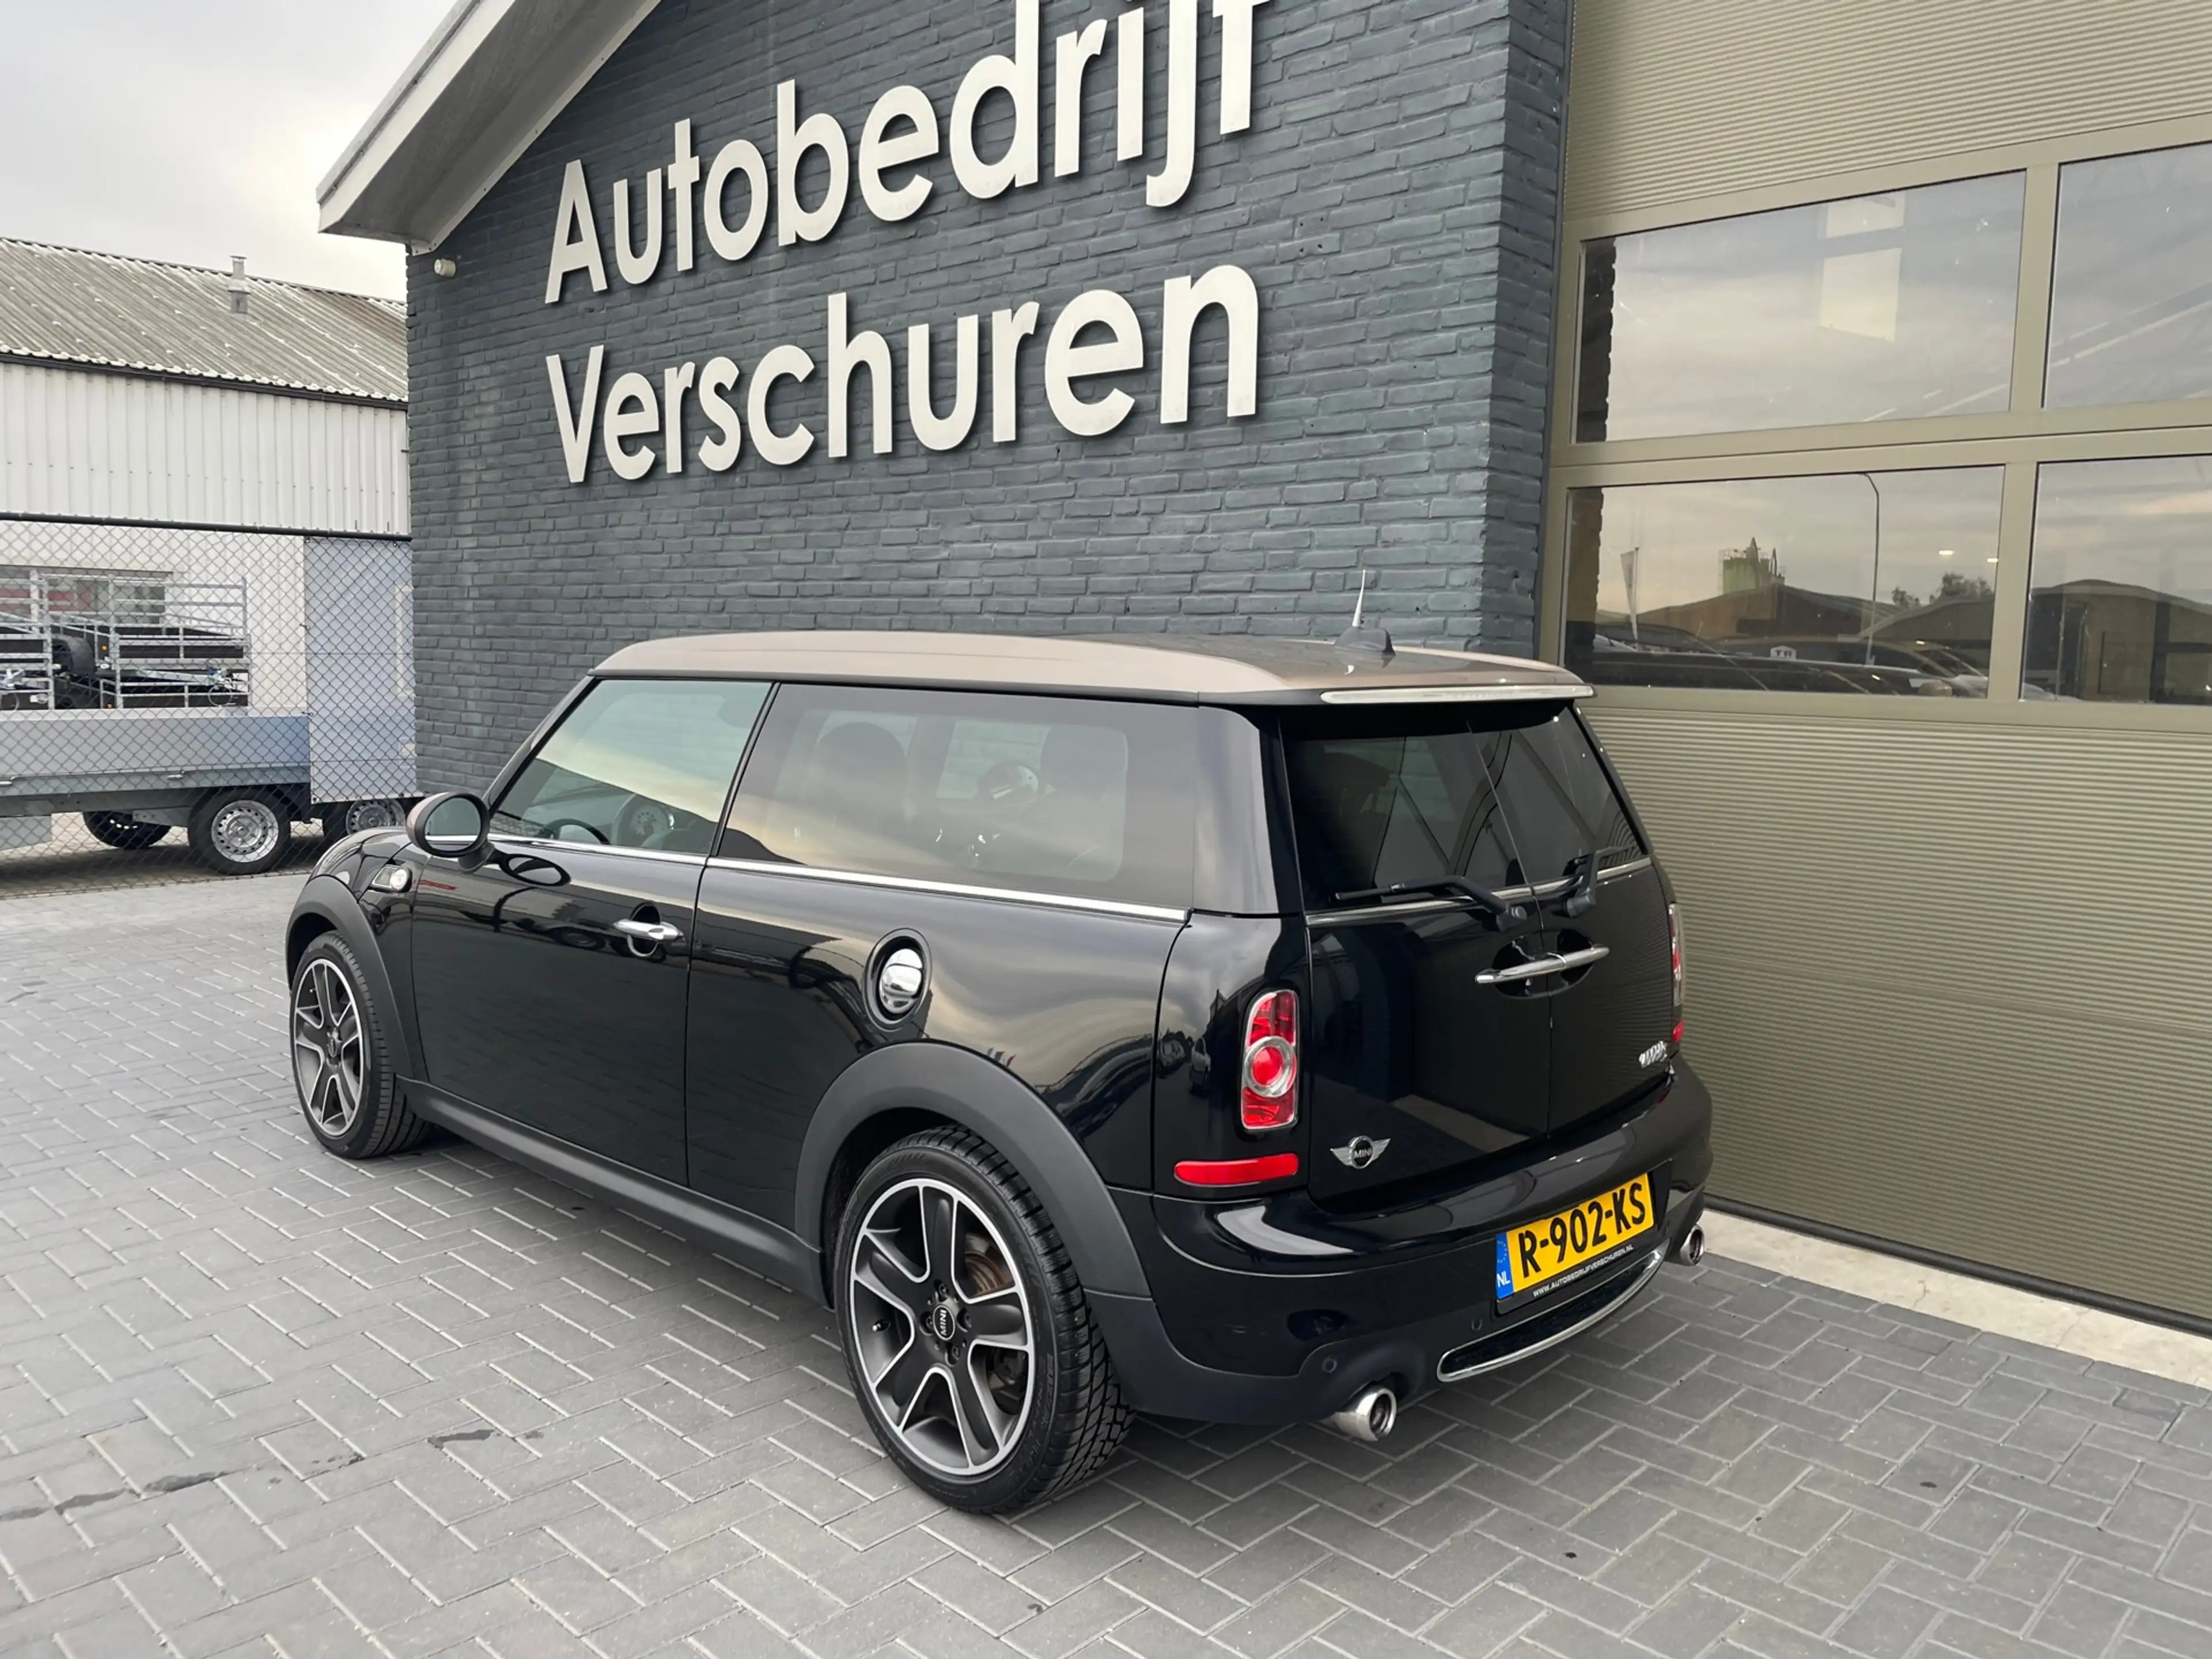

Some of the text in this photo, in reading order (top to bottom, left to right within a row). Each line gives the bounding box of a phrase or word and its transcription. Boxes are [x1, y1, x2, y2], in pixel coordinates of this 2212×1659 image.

[545, 0, 1268, 304] Autobedrijf
[546, 264, 1259, 484] Verschuren
[1354, 1147, 1372, 1158] MINI
[1518, 1183, 1646, 1278] R-902-KS
[1497, 1271, 1511, 1287] NL
